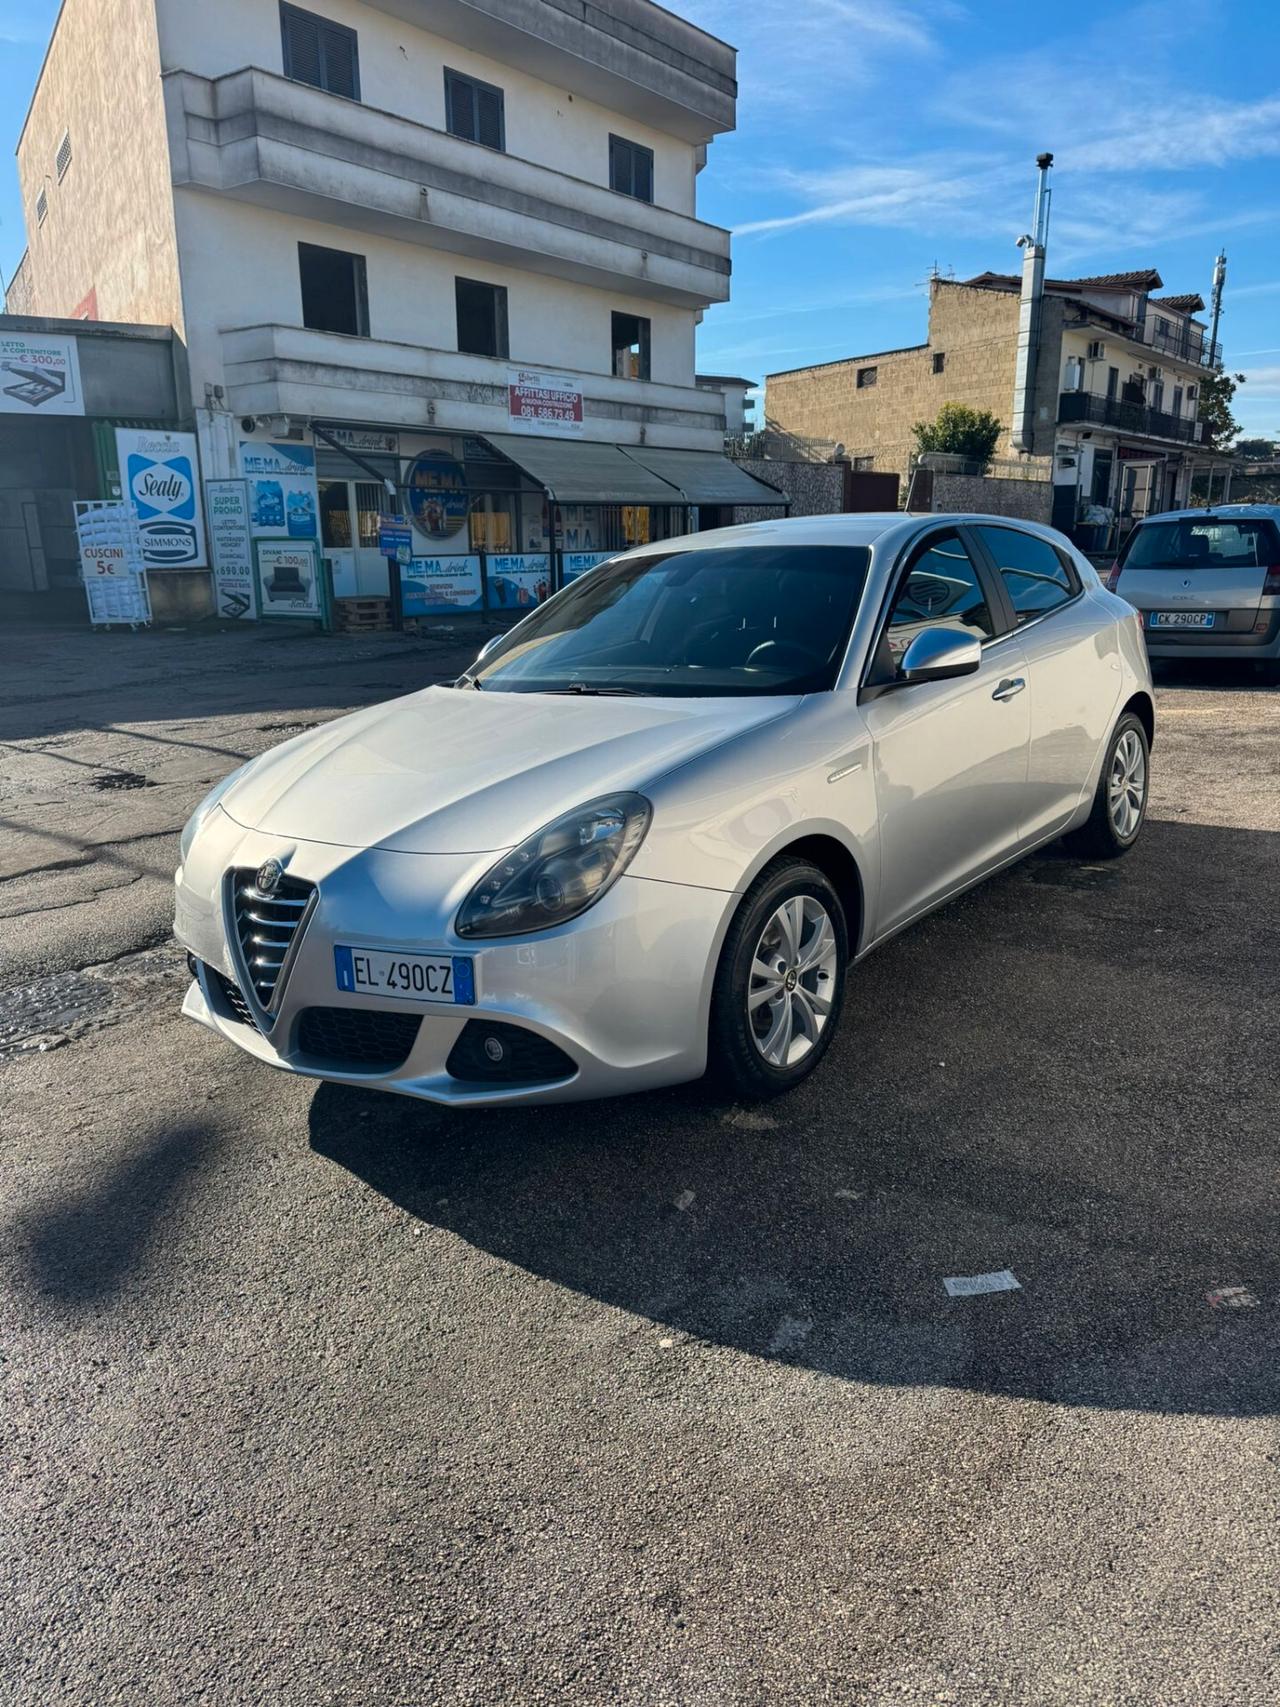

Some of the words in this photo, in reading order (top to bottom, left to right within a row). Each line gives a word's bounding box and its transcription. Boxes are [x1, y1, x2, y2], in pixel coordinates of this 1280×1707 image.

[514, 387, 550, 400] AFFITTASI
[550, 390, 578, 403] UFFICIO
[138, 473, 182, 501] Sealy
[214, 496, 241, 505] SUPER
[213, 506, 243, 515] PROMO
[144, 537, 192, 548] SIMMONS
[84, 548, 124, 558] CUSCINI
[1158, 613, 1172, 624] CK
[1175, 613, 1206, 625] 290CP
[354, 957, 379, 986] EL
[386, 962, 453, 994] 490CZ
